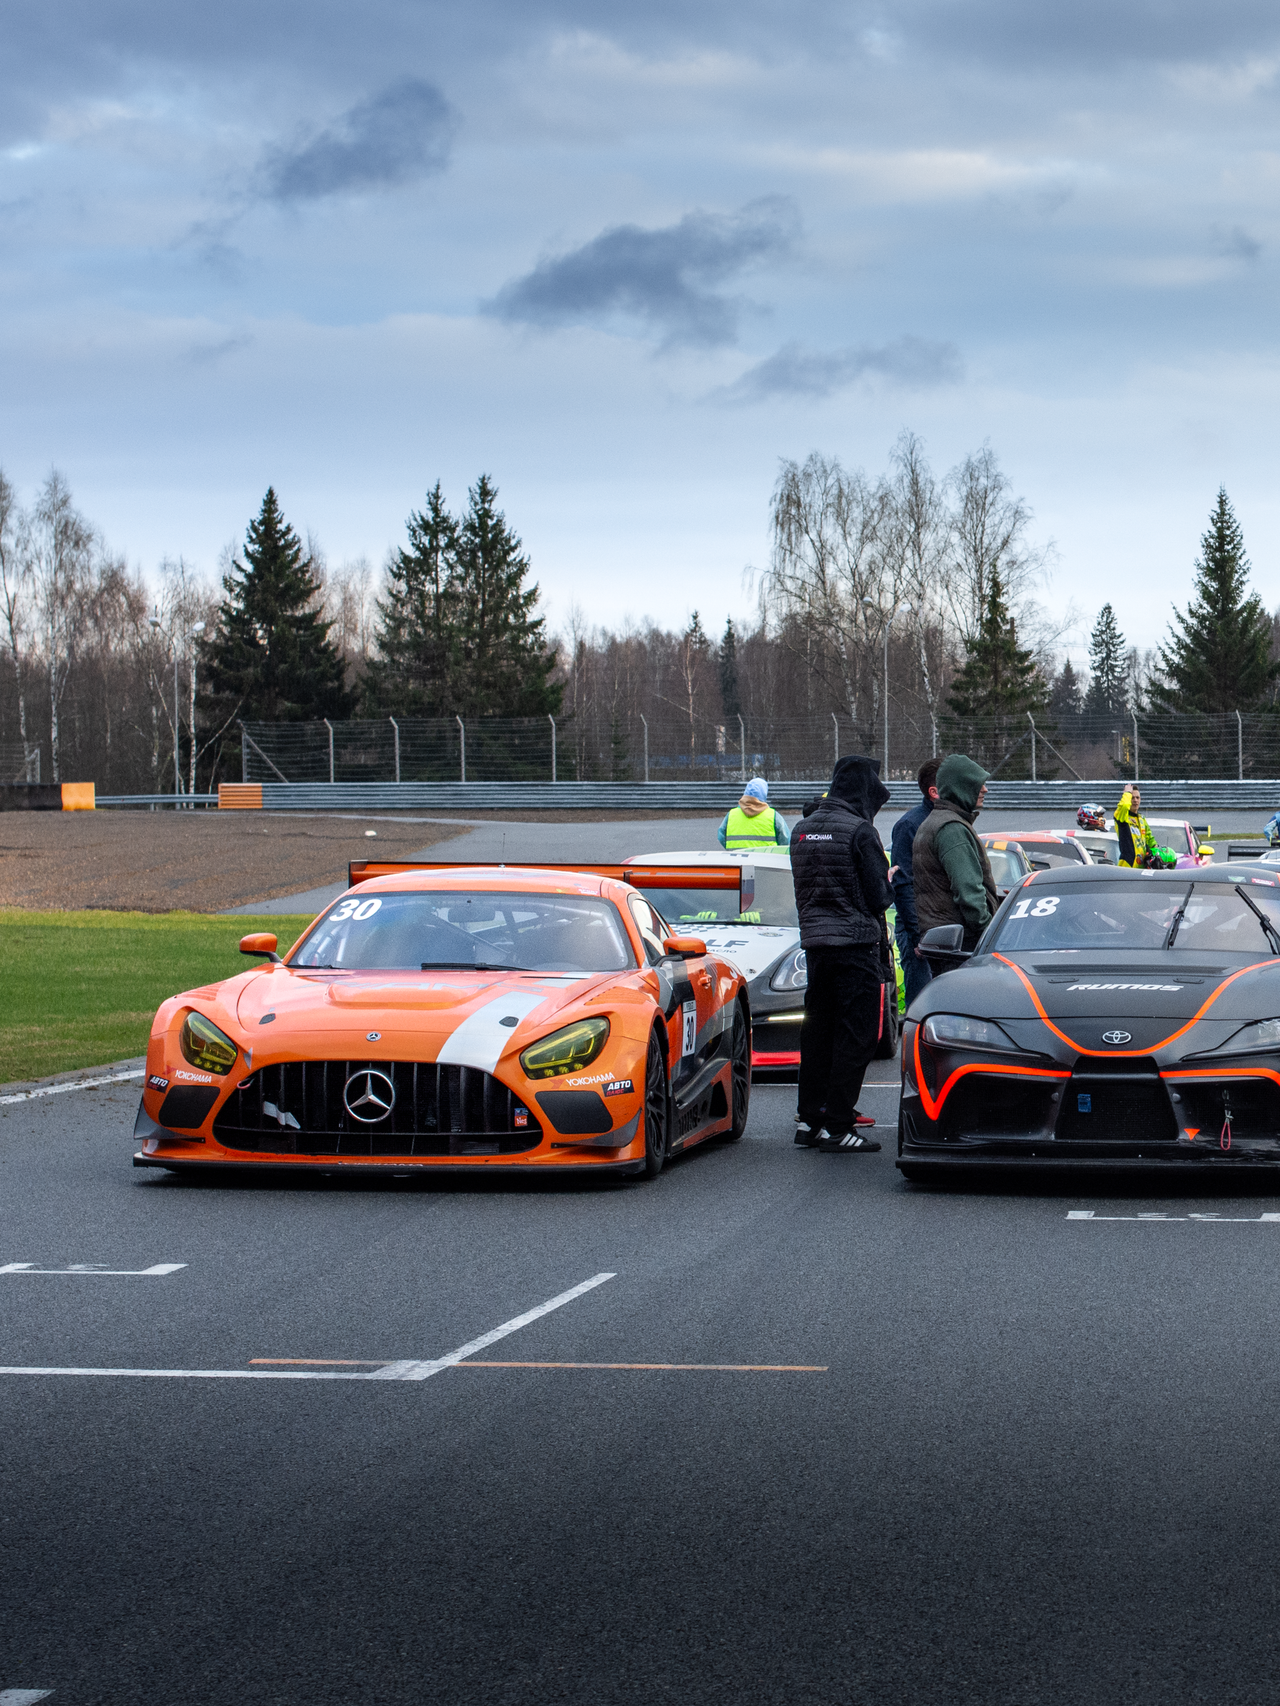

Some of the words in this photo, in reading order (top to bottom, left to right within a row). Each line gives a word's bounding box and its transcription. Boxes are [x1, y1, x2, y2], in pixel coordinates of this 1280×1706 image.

[329, 899, 382, 922] 30
[1009, 897, 1060, 919] 18
[706, 939, 750, 948] LF
[685, 1016, 695, 1051] 30
[150, 1076, 168, 1087] АВТО
[175, 1069, 212, 1083] YOKOHAMA
[565, 1072, 615, 1087] YOKOHAMA
[607, 1080, 631, 1091] АВТО
